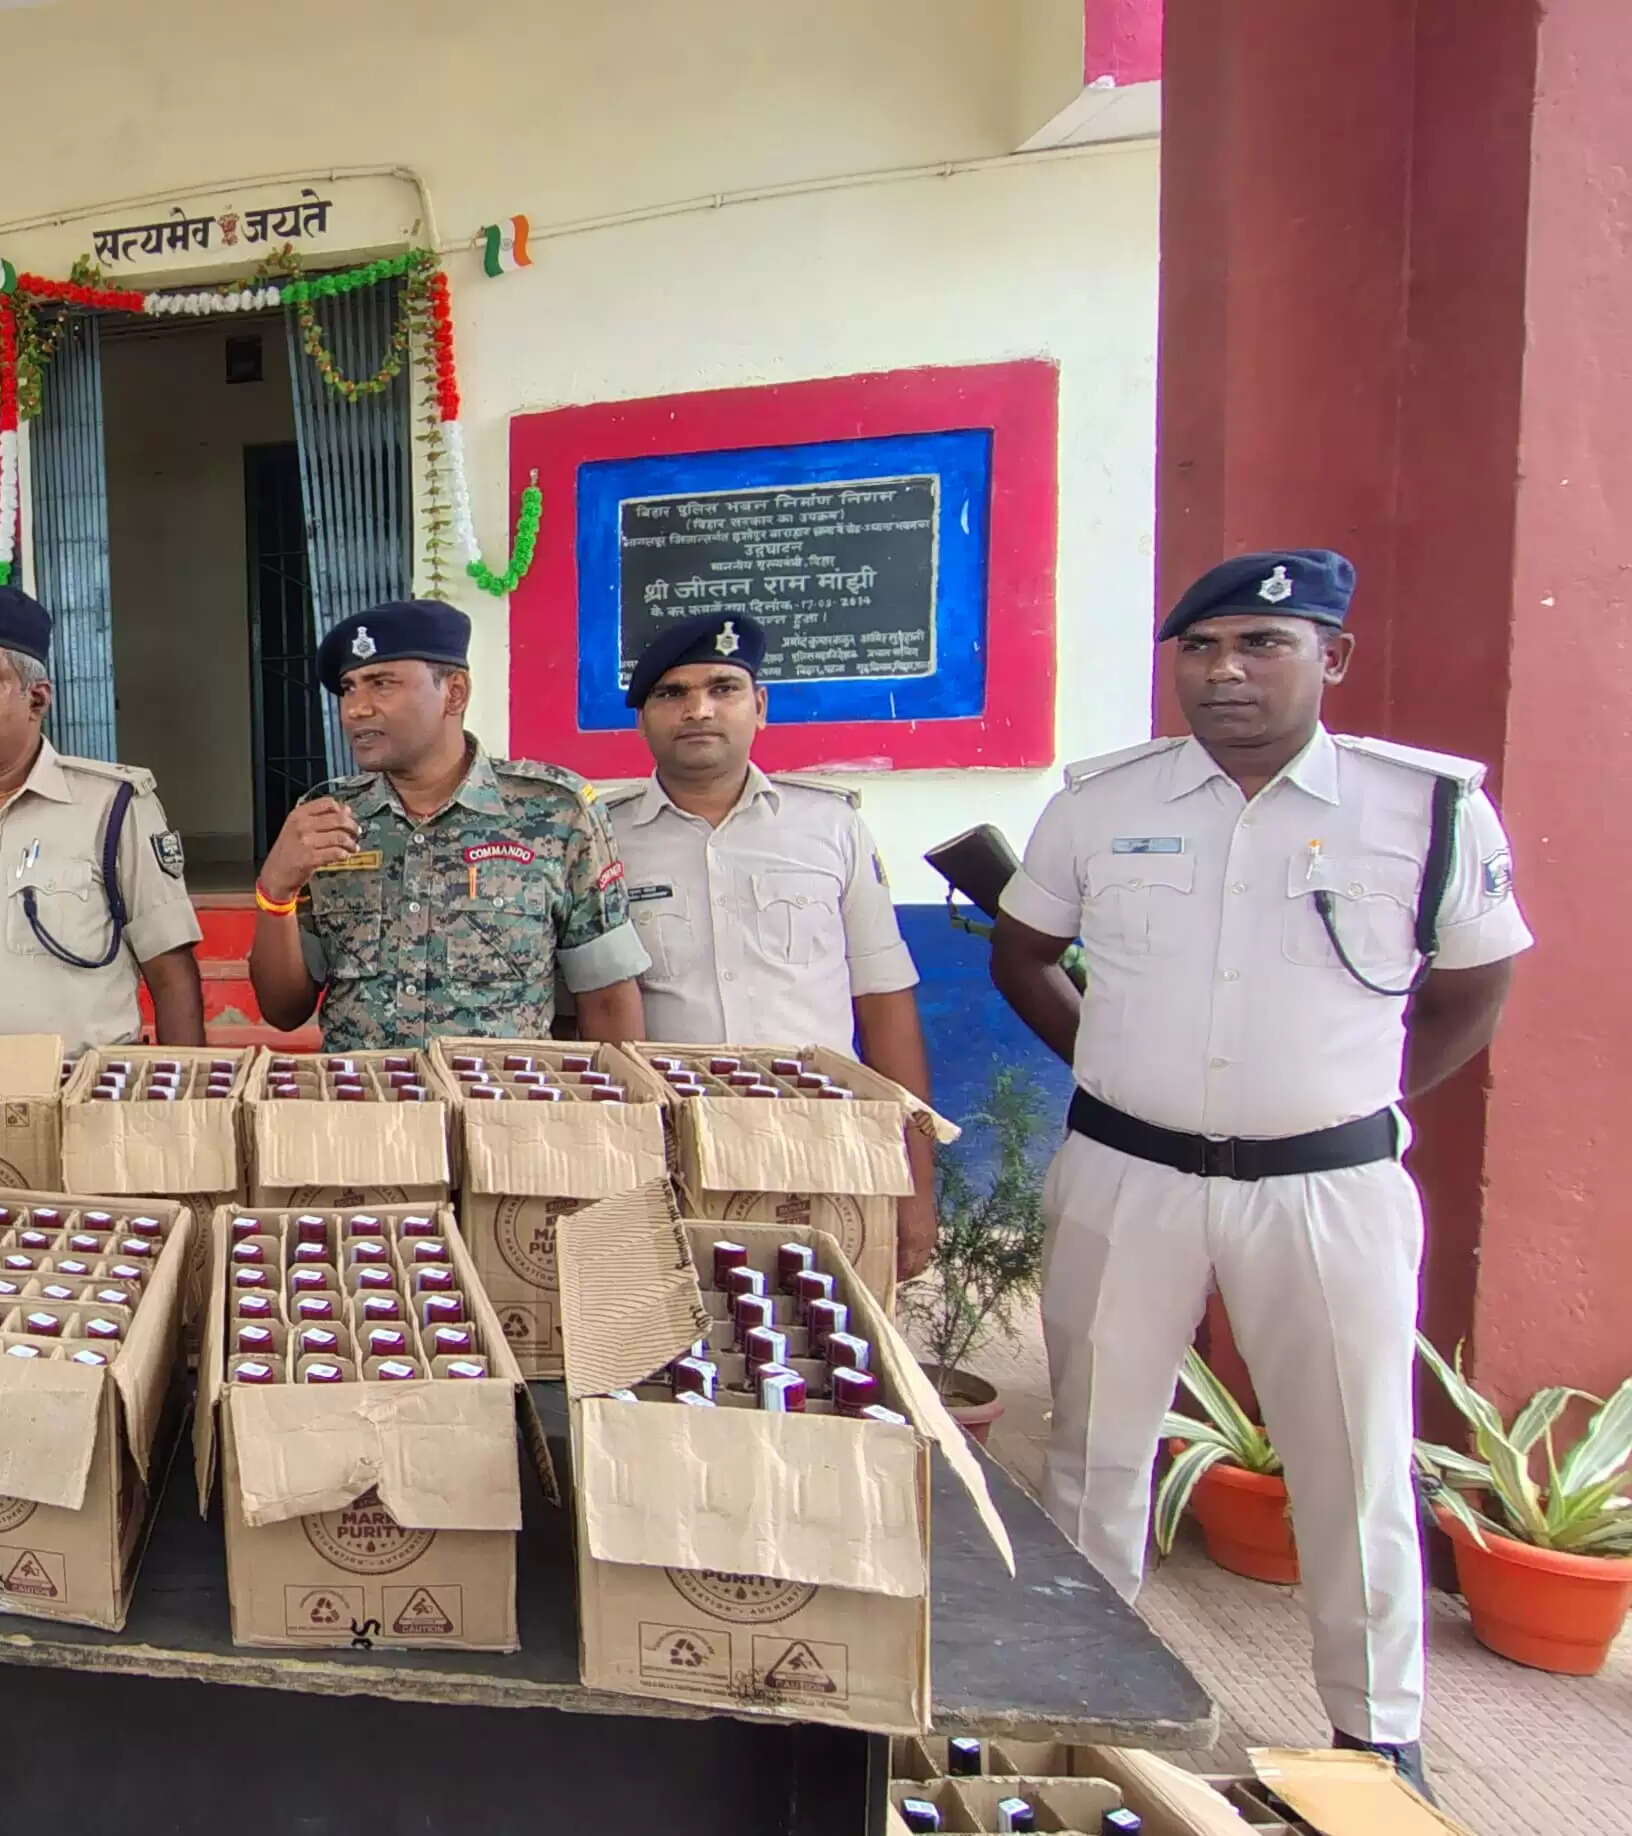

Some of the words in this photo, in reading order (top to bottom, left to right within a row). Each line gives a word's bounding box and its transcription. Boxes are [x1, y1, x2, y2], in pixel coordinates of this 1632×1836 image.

[93, 206, 216, 268] सत्यमेव
[241, 188, 333, 243] जयते
[636, 503, 671, 519] बिहार
[676, 501, 718, 517] पुलिस
[725, 499, 770, 513] भवन
[774, 493, 834, 508] निर्माण
[730, 514, 773, 528] सरकार
[643, 578, 669, 603] श्री
[674, 575, 754, 598] जीतन
[764, 575, 811, 595] राम
[816, 565, 878, 594] मांझी
[469, 845, 531, 861] COMMANDO
[336, 1525, 407, 1539] PURITY
[701, 1569, 782, 1589] PURITY
[401, 1625, 444, 1633] CAUTION
